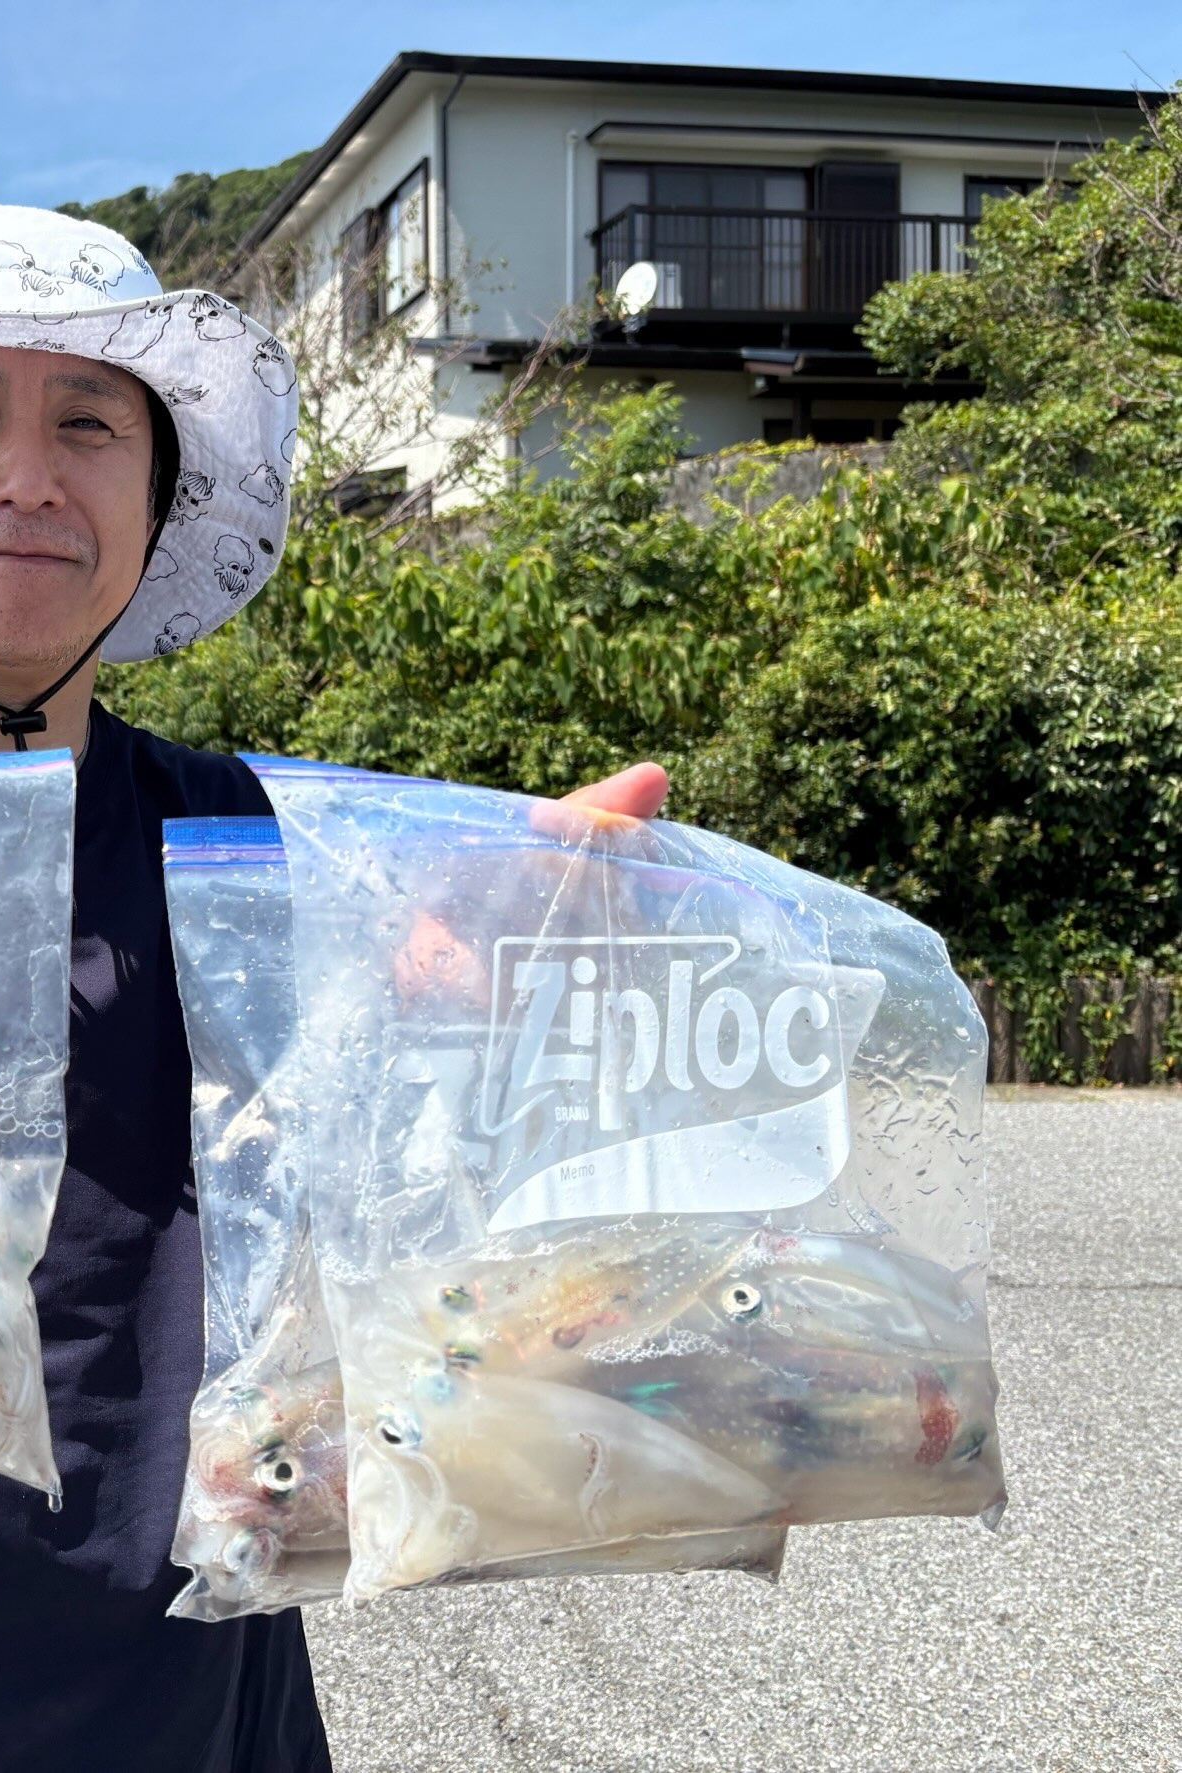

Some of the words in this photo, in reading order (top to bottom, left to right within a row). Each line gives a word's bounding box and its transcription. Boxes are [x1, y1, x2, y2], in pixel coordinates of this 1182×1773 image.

[512, 957, 832, 1131] Ziploc
[555, 1106, 589, 1121] BRAND
[560, 1164, 595, 1181] Memo
